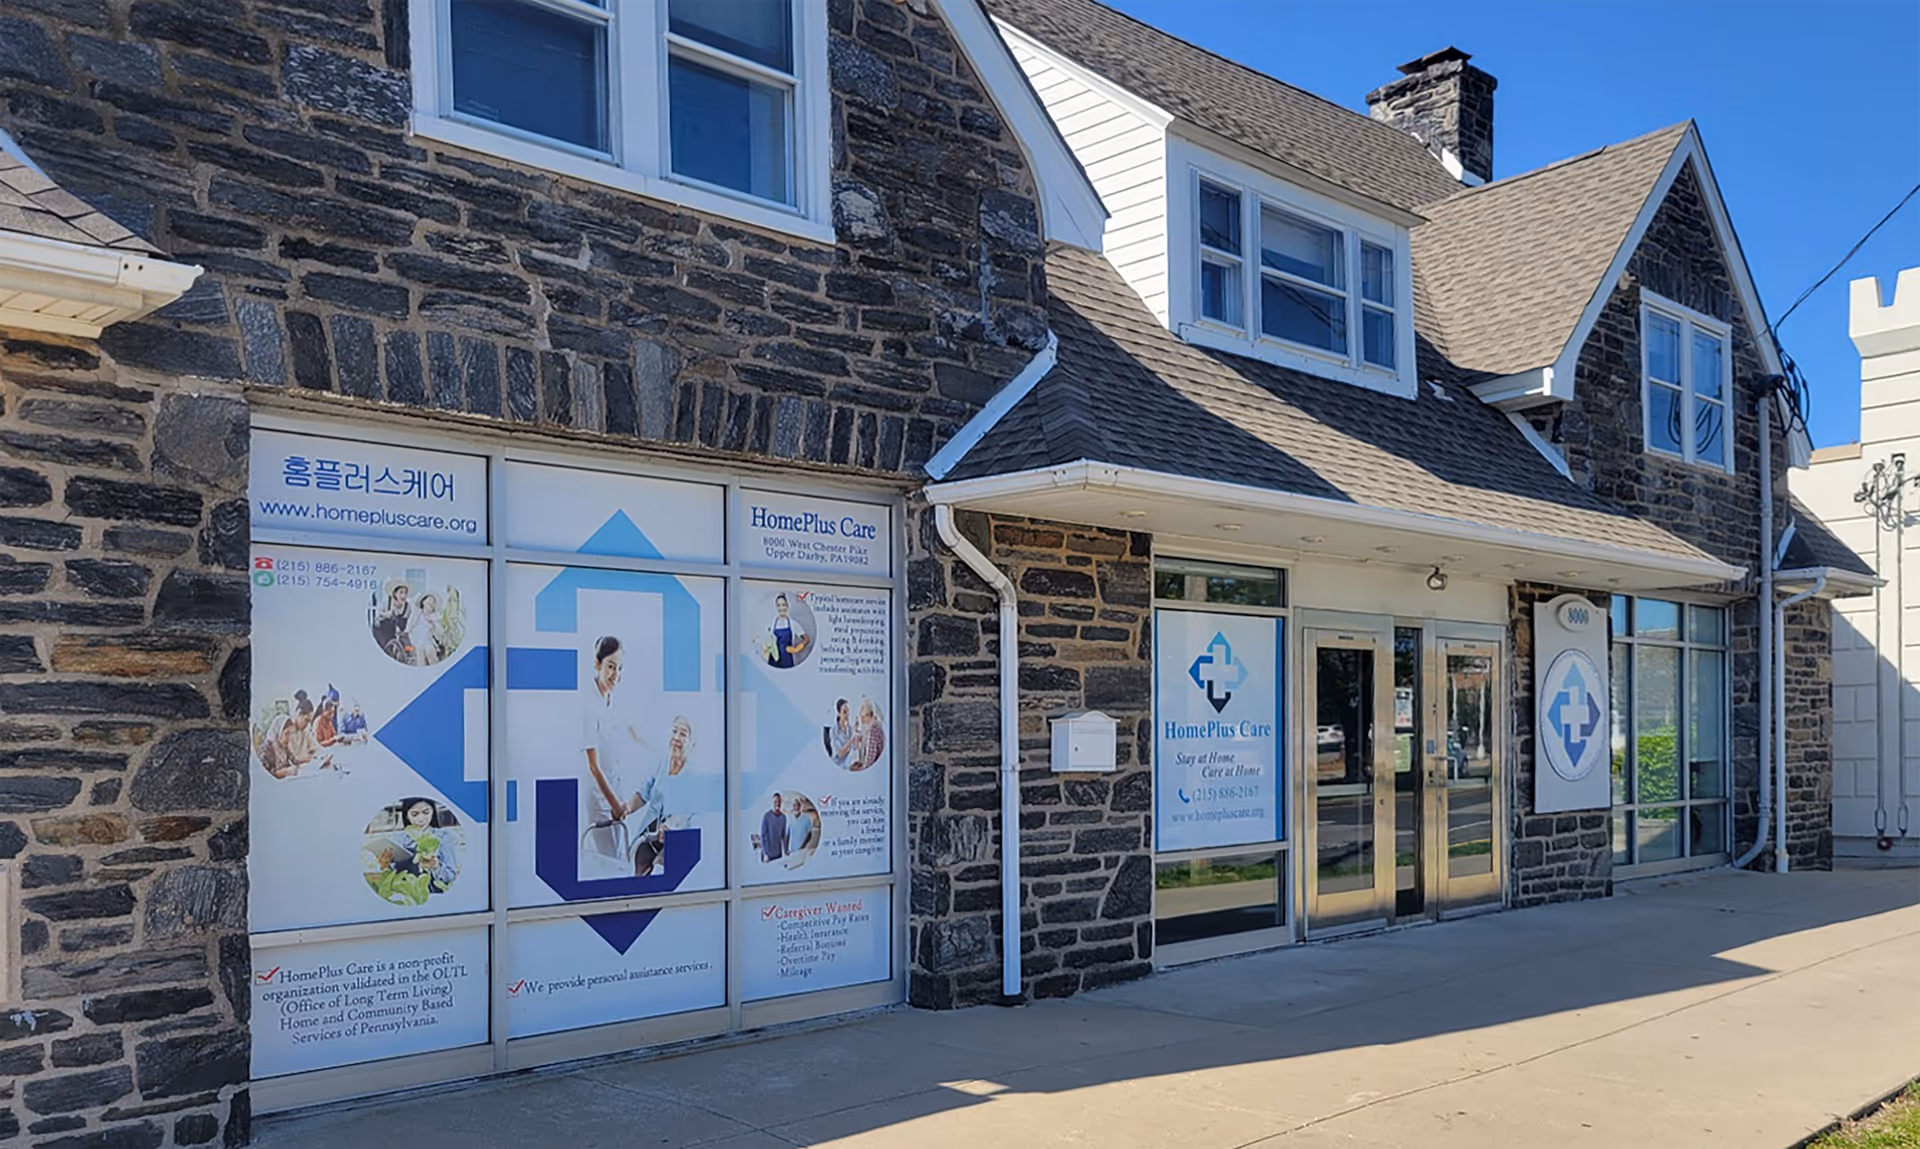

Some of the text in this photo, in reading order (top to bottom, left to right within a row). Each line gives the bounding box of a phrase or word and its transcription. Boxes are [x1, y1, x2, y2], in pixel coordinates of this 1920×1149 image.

[283, 456, 454, 501] 홈플러스케어
[259, 500, 477, 534] www.homepluscare.org
[751, 506, 876, 539] HomePlus Care
[763, 536, 868, 555] 8000 West Chester Pike
[766, 547, 794, 561] Upper
[276, 559, 376, 575] (215) 886-2167
[277, 574, 377, 590] (215) 754-4916
[1567, 607, 1589, 625] 8000
[1165, 720, 1271, 740] HomePlus Care
[1175, 752, 1235, 767] Stay at Home
[1201, 765, 1261, 779] Care at Home
[1192, 787, 1217, 804] (215)
[1171, 807, 1265, 823] www.homepluscare.org
[774, 898, 863, 921] Caregiver Wanted
[832, 914, 846, 927] Pay
[848, 913, 870, 922] Rates
[810, 927, 849, 940] Insurance
[815, 939, 846, 951] Bonuses
[821, 951, 835, 963] Pay
[279, 951, 455, 984] HomePlus Care is a non-profit
[262, 964, 468, 1004] organization validated in the OLTL
[525, 981, 545, 994] We
[548, 974, 586, 994] provide
[587, 968, 628, 989] personal
[629, 964, 674, 980] assistance
[280, 981, 454, 1017] (Office of Long Term Living)
[280, 996, 454, 1031] Home and Community Based
[292, 1013, 439, 1045] Services of Pennsylvania.
